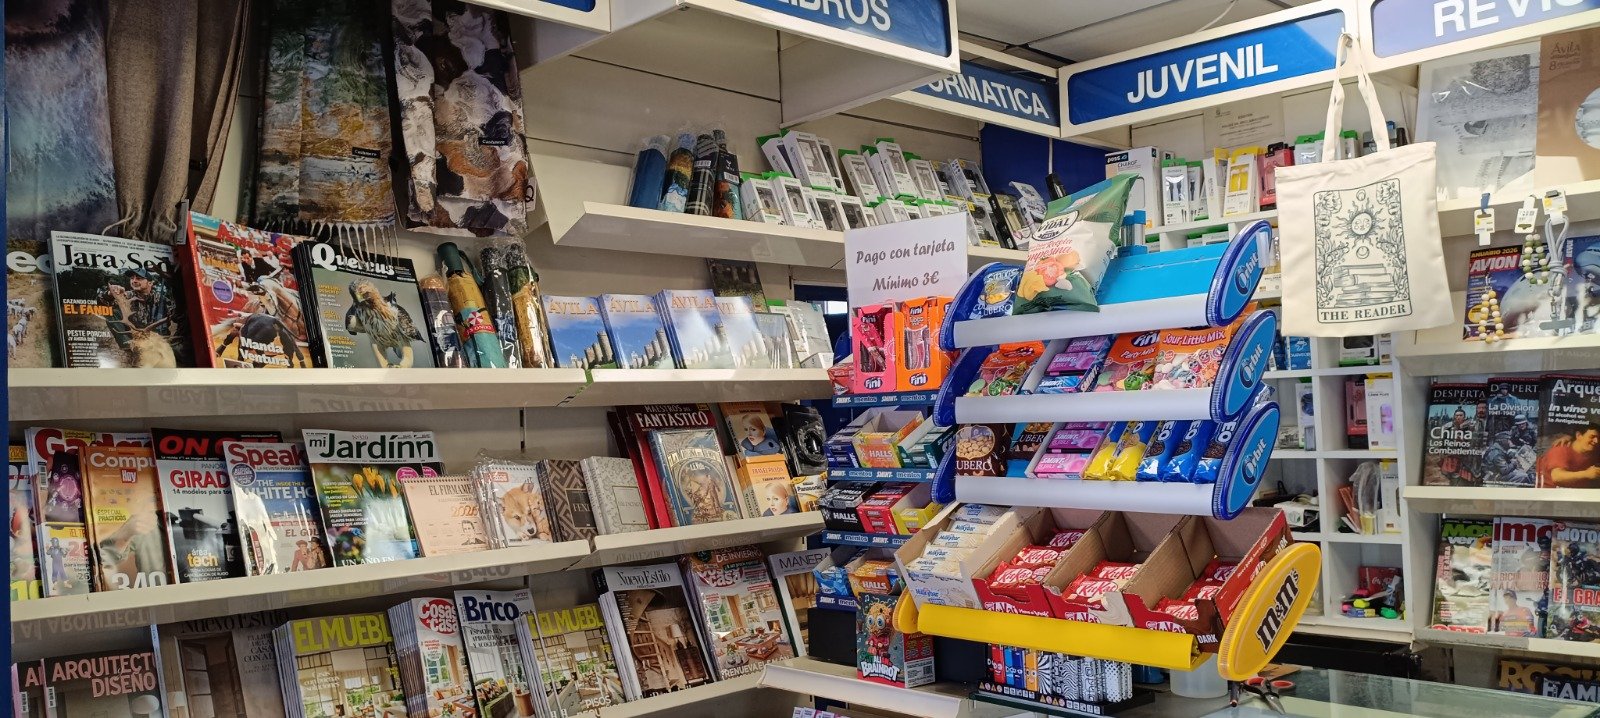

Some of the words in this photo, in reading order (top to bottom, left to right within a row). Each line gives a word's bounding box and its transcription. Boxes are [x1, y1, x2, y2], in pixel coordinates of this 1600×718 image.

[1127, 43, 1278, 104] JUVENIL
[59, 243, 119, 269] Jara
[120, 258, 127, 267] y
[311, 242, 395, 276] Quercus
[856, 249, 886, 266] Pago
[889, 247, 911, 259] con
[913, 239, 955, 257] tarjeta
[1470, 255, 1519, 272] AVION
[872, 275, 919, 291] Mínimo
[923, 271, 940, 285] 3€
[549, 298, 599, 315] ÁVILA
[610, 298, 656, 314] ÁVILA
[671, 293, 716, 310] ÁVILA
[64, 304, 78, 314] EL
[80, 305, 113, 316] FANDI
[1320, 311, 1349, 321] THE
[1354, 303, 1407, 318] READER
[240, 336, 285, 354] Manda
[1162, 333, 1182, 345] Sour
[1182, 333, 1206, 346] Little
[1207, 330, 1225, 344] Mix
[239, 347, 291, 367] Ventura
[1239, 343, 1264, 389] Orbit
[1434, 389, 1486, 398] DESPERTA
[1489, 403, 1499, 411] La
[1548, 402, 1560, 412] In
[1562, 404, 1588, 414] vino
[1430, 426, 1473, 440] China
[159, 435, 209, 455] ON
[309, 436, 327, 448] mi
[1444, 439, 1471, 448] Reinos
[869, 450, 893, 458] HALLS
[1241, 437, 1268, 485] Orbit
[122, 469, 137, 483] Hoy
[170, 469, 230, 489] GIRAD
[256, 479, 274, 487] THE
[244, 486, 292, 500] WHITE
[428, 485, 439, 496] EL
[833, 512, 857, 520] HALLS
[285, 529, 297, 537] EL
[187, 553, 219, 567] tech
[360, 556, 380, 566] AÑO
[997, 568, 1032, 582] KitKat
[862, 581, 887, 590] HALLS
[1079, 581, 1118, 597] KitKat
[418, 598, 457, 619] Cosas
[463, 594, 520, 622] Brico
[294, 620, 323, 653] EL
[321, 613, 393, 649] MUEBL
[1197, 634, 1219, 643] DARK
[860, 661, 900, 682] BRAINROT
